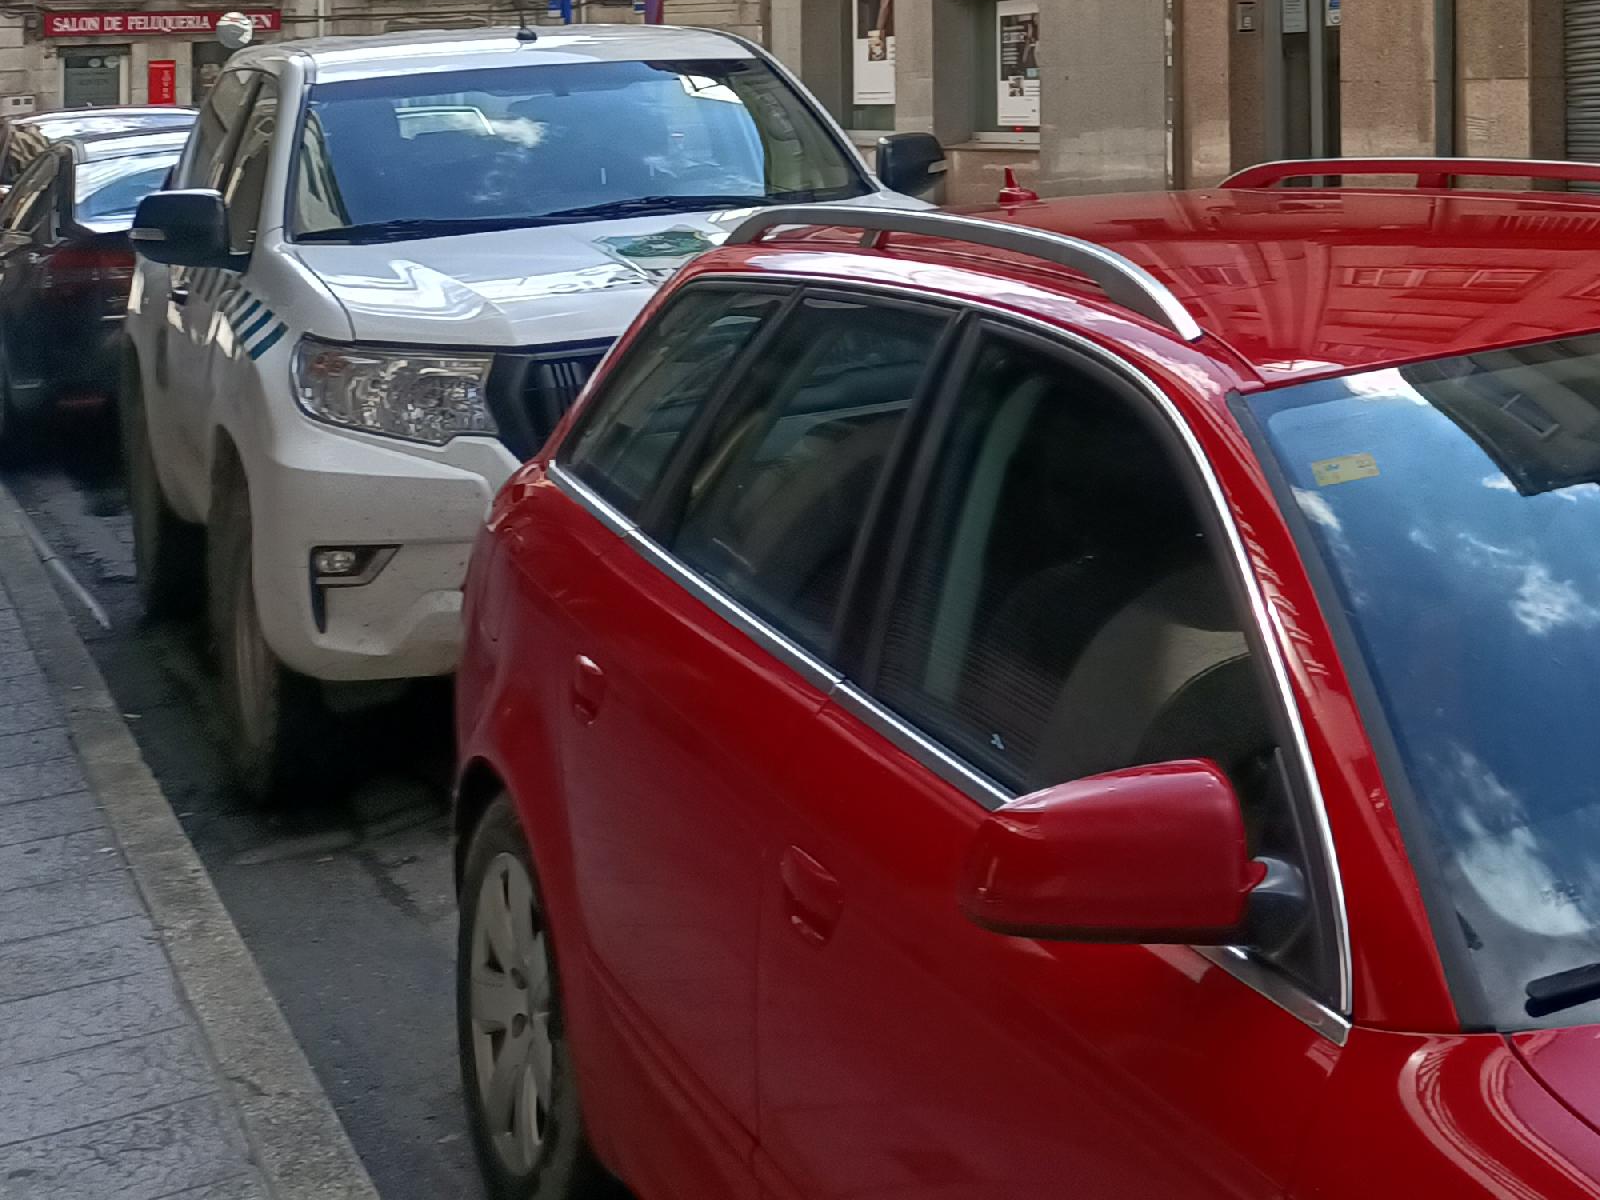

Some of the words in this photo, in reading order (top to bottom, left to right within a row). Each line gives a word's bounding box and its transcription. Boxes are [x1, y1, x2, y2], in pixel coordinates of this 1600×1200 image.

[53, 16, 100, 32] SALON
[103, 16, 123, 31] DE
[127, 15, 211, 32] PELUQUERIA
